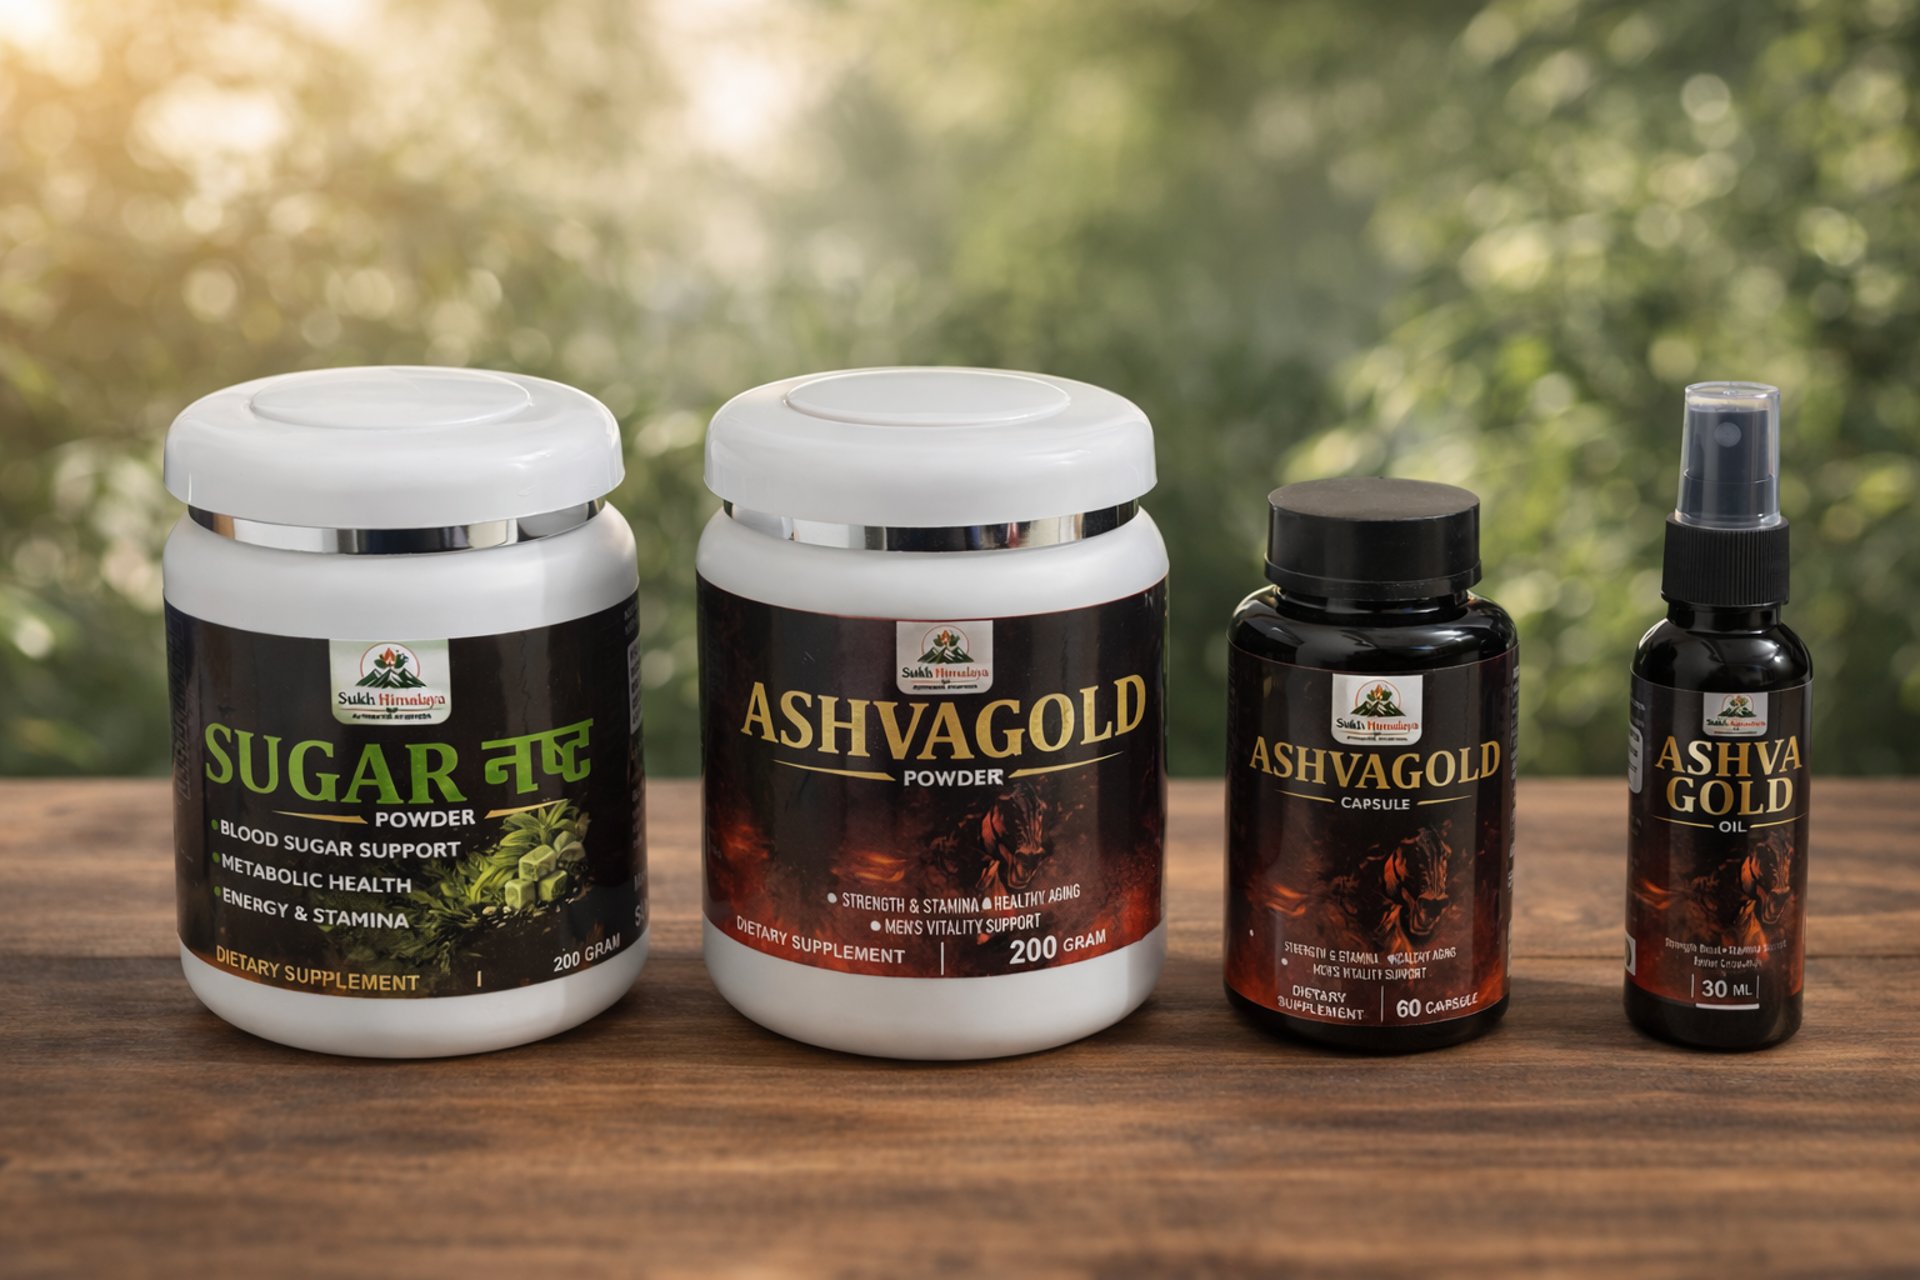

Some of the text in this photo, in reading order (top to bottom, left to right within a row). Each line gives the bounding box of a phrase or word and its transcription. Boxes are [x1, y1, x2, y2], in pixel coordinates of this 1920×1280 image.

[740, 674, 1147, 761] ASHVAGOLD
[204, 722, 468, 805] SUGAR
[481, 718, 594, 794] नष्ट
[1248, 735, 1501, 790] ASHVAGOLD
[1655, 735, 1803, 778] ASHVA
[903, 768, 1004, 788] POWDER
[1665, 776, 1794, 816] GOLD
[375, 809, 476, 828] POWDER
[1341, 796, 1411, 811] CAPSULE
[220, 819, 461, 859] BLOOD SUGAR SUPPORT
[1718, 820, 1748, 833] OIL
[221, 853, 412, 893] METABOLIC HEALTH
[222, 887, 410, 930] ENERGY & STAMINA
[842, 883, 1081, 914] STRENGTH & STAMINA HEALTHY AGING
[736, 914, 906, 964] DIETARY SUPPLEMENT
[926, 918, 984, 936] VITALITY
[985, 912, 1041, 934] SUPPORT
[553, 933, 621, 973] 200 GRAM
[1009, 929, 1107, 965] 200 GRAM
[216, 945, 421, 992] DIETARY SUPPLEMENT
[1701, 979, 1753, 998] 30 ML
[1396, 999, 1422, 1018] 60
